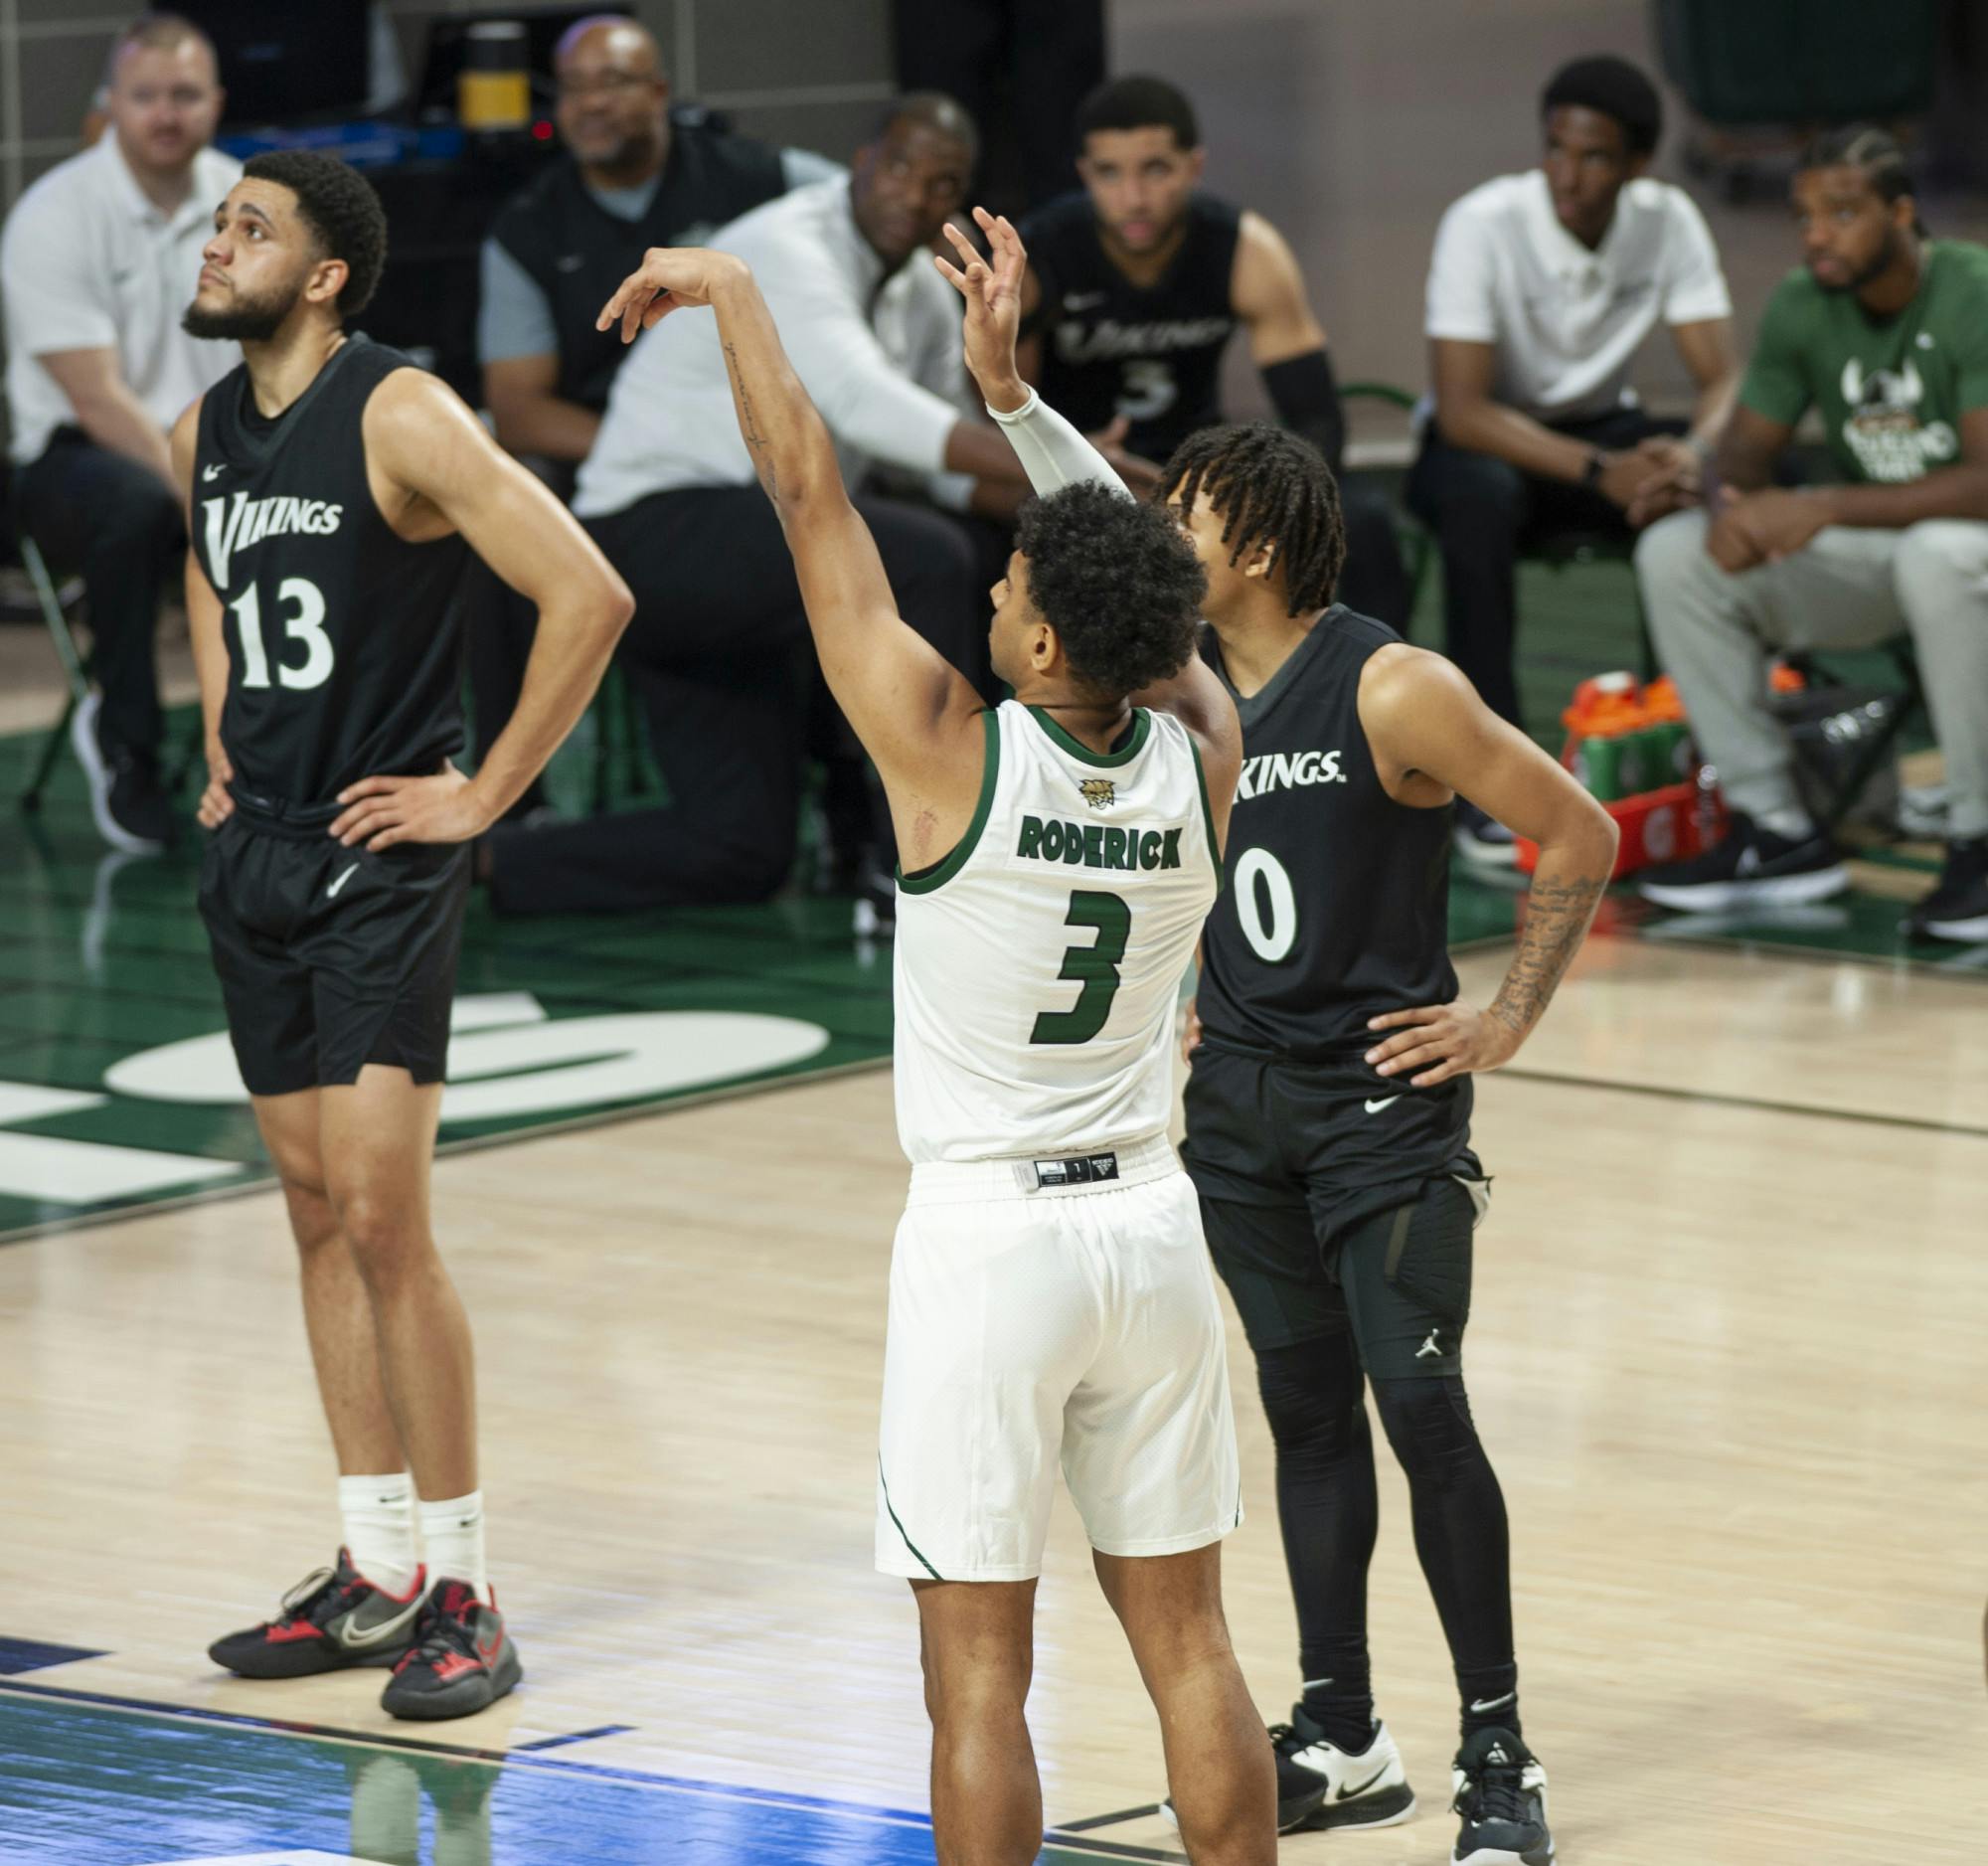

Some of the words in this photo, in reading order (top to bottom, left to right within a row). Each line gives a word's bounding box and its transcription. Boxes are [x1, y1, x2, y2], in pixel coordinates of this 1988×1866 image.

[202, 491, 344, 591] VIKINGS
[229, 577, 335, 690] 13
[1233, 751, 1341, 805] KINGS
[1016, 815, 1183, 871] RODERICK
[1234, 847, 1297, 962] 0
[1029, 889, 1132, 1045] 3
